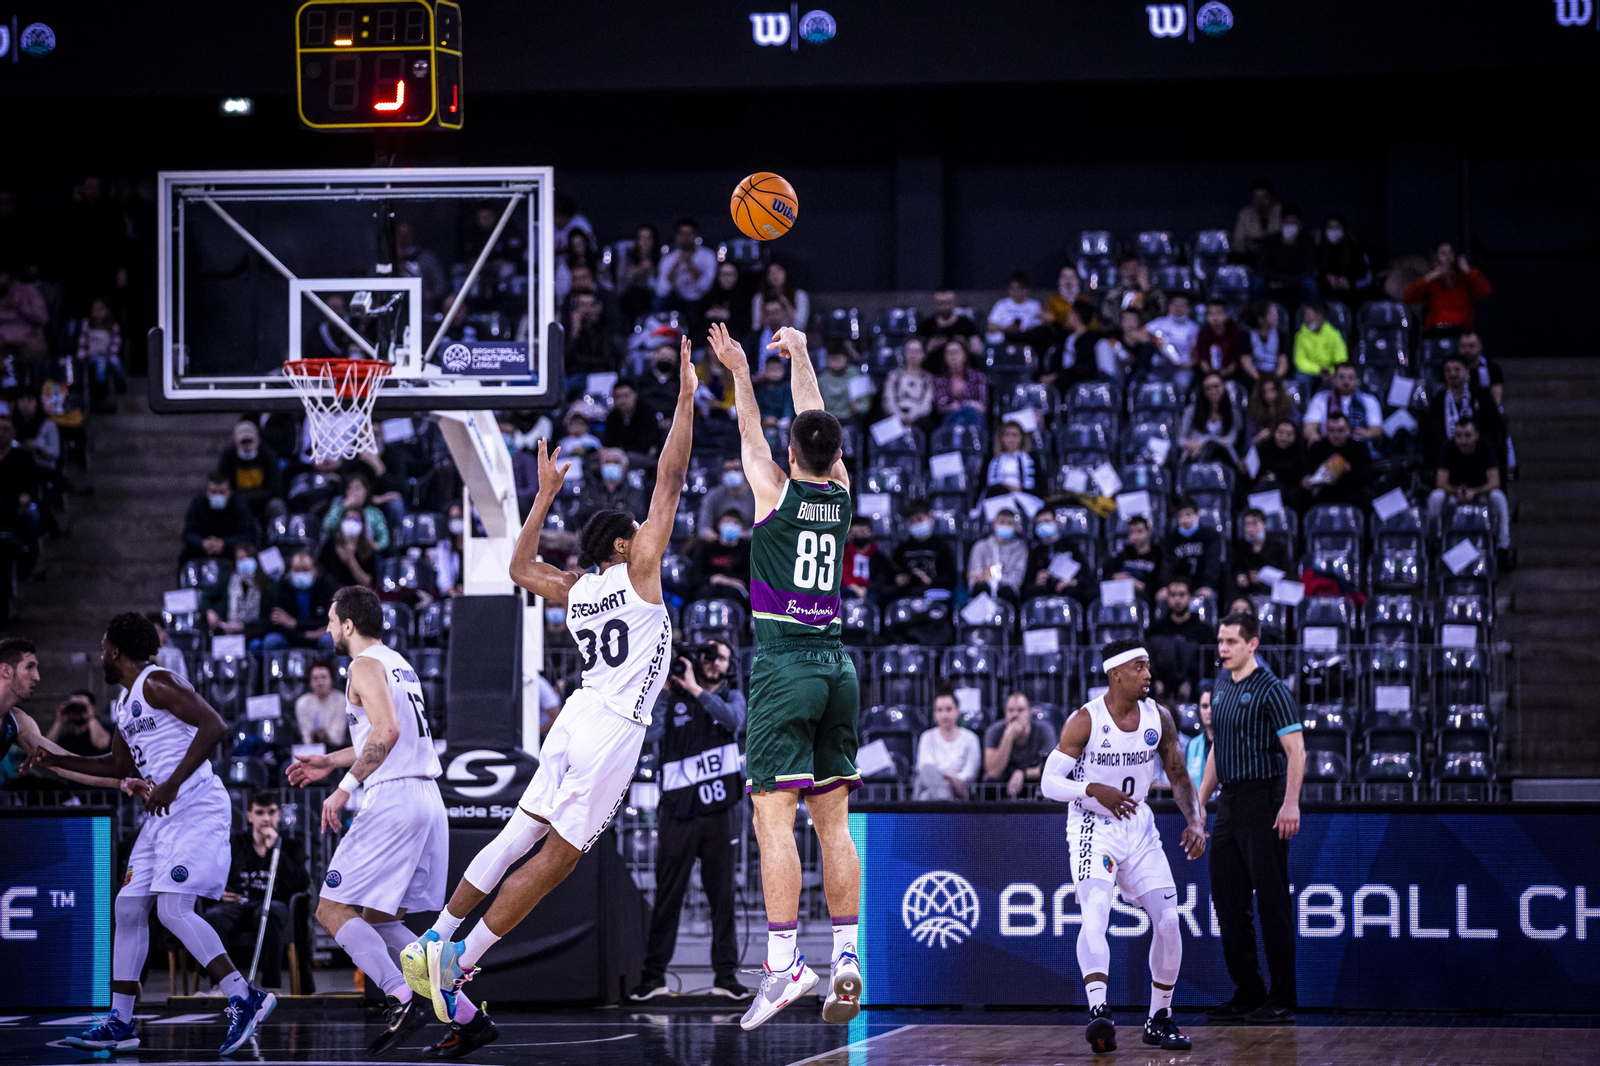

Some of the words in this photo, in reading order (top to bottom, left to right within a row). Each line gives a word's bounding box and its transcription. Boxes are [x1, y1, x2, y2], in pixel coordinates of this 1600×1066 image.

[472, 354, 525, 363] CHAMPIONS
[797, 501, 841, 522] BOUTEILLE
[793, 530, 836, 591] 83
[571, 589, 627, 619] STEWART
[575, 618, 630, 672] 30
[698, 779, 727, 805] 08
[1122, 776, 1135, 797] 0
